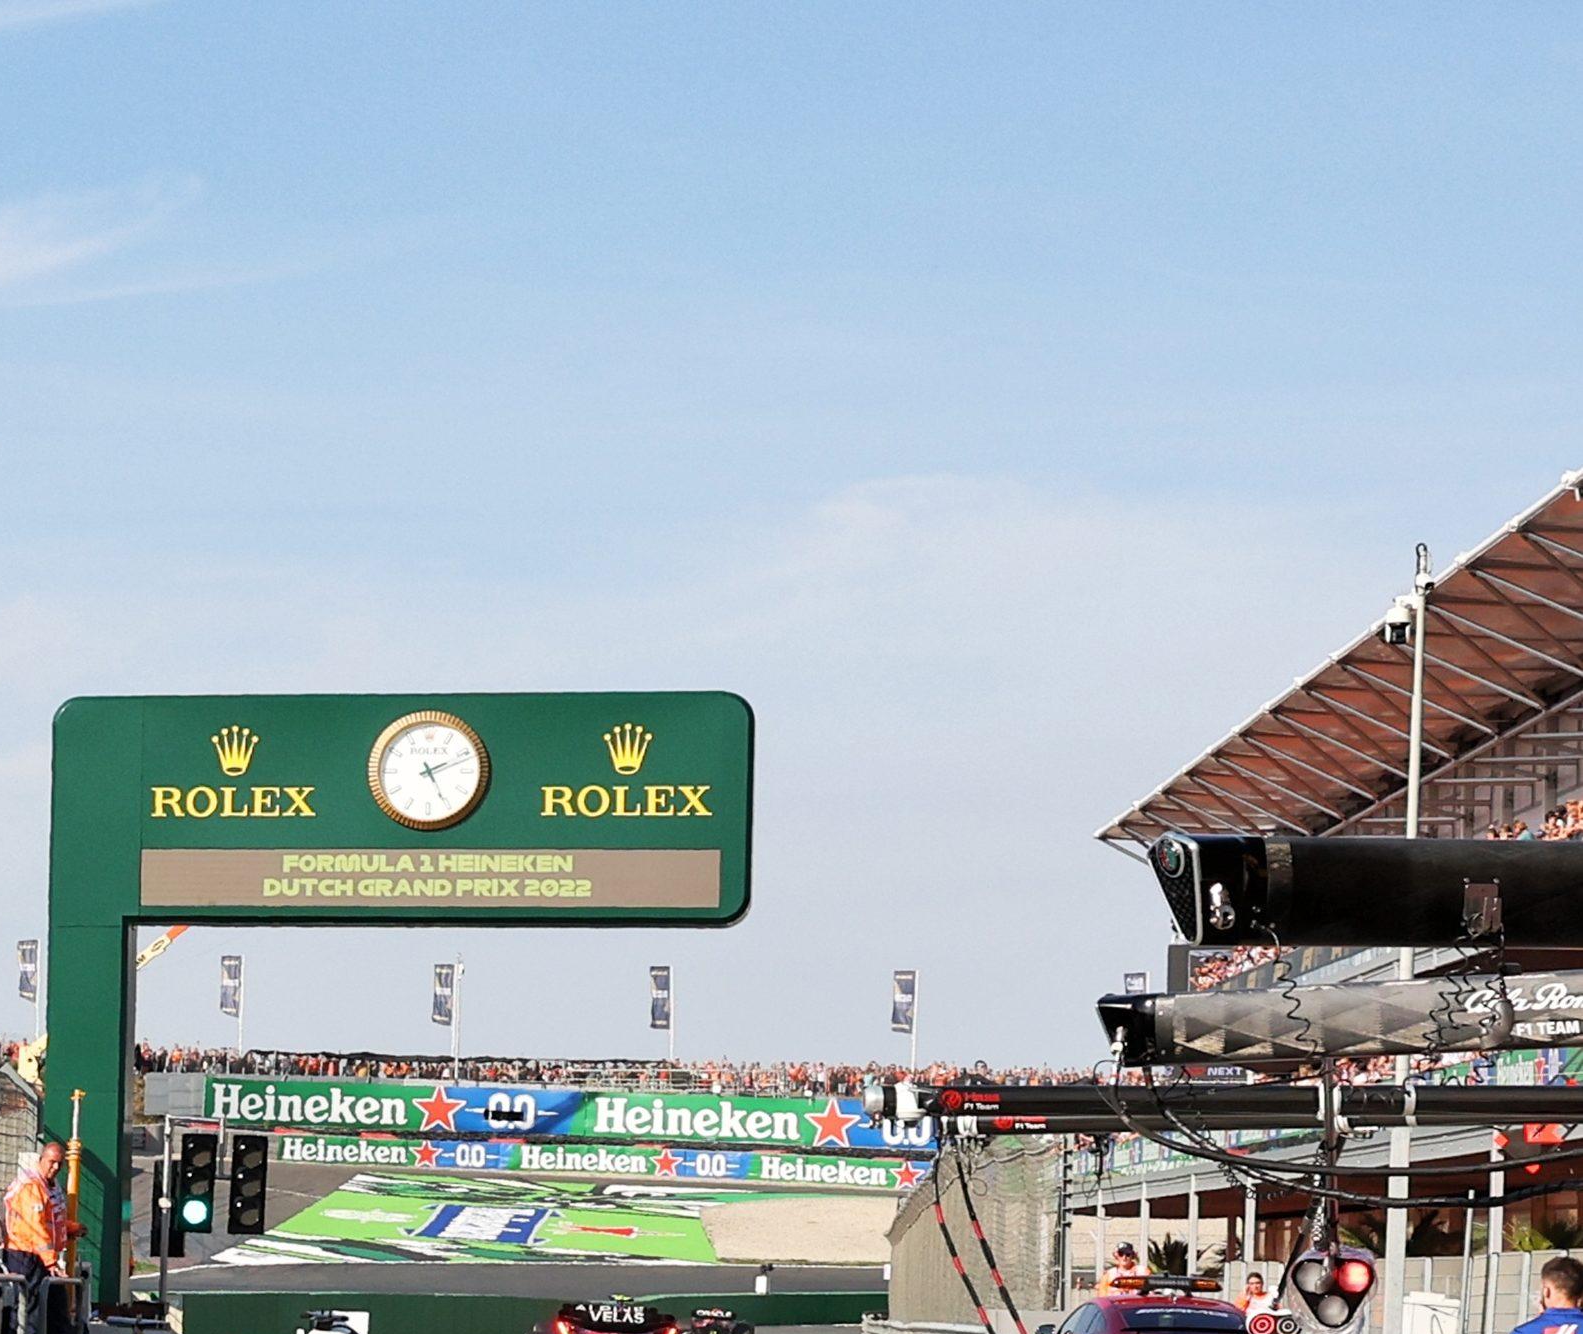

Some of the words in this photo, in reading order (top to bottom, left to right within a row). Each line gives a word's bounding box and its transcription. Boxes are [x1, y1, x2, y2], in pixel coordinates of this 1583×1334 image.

[410, 746, 449, 756] ROLEX
[150, 786, 316, 818] ROLEX
[540, 785, 713, 818] ROLEX
[283, 854, 415, 873] FORMULA
[419, 854, 434, 873] 1
[438, 854, 574, 873] HEINEKEN
[263, 878, 354, 897] DUTCH
[357, 878, 452, 897] GRAND
[455, 878, 518, 897] PRIX
[523, 878, 593, 897] 2022
[1516, 1023, 1533, 1036] F1
[1536, 1021, 1581, 1035] TEAM
[1207, 1065, 1244, 1077] NEXT
[212, 1082, 408, 1127] Heineken
[964, 1103, 975, 1111] F1
[976, 1103, 1000, 1111] Team
[593, 1096, 801, 1141] Heineken
[283, 1138, 408, 1164] Heineken
[455, 1143, 485, 1167] 0.0
[520, 1145, 648, 1174] Heineken
[696, 1152, 726, 1176] 0.0
[760, 1156, 887, 1187] Heineken
[589, 1309, 645, 1325] VELAS
[696, 1308, 733, 1319] ORACLE
